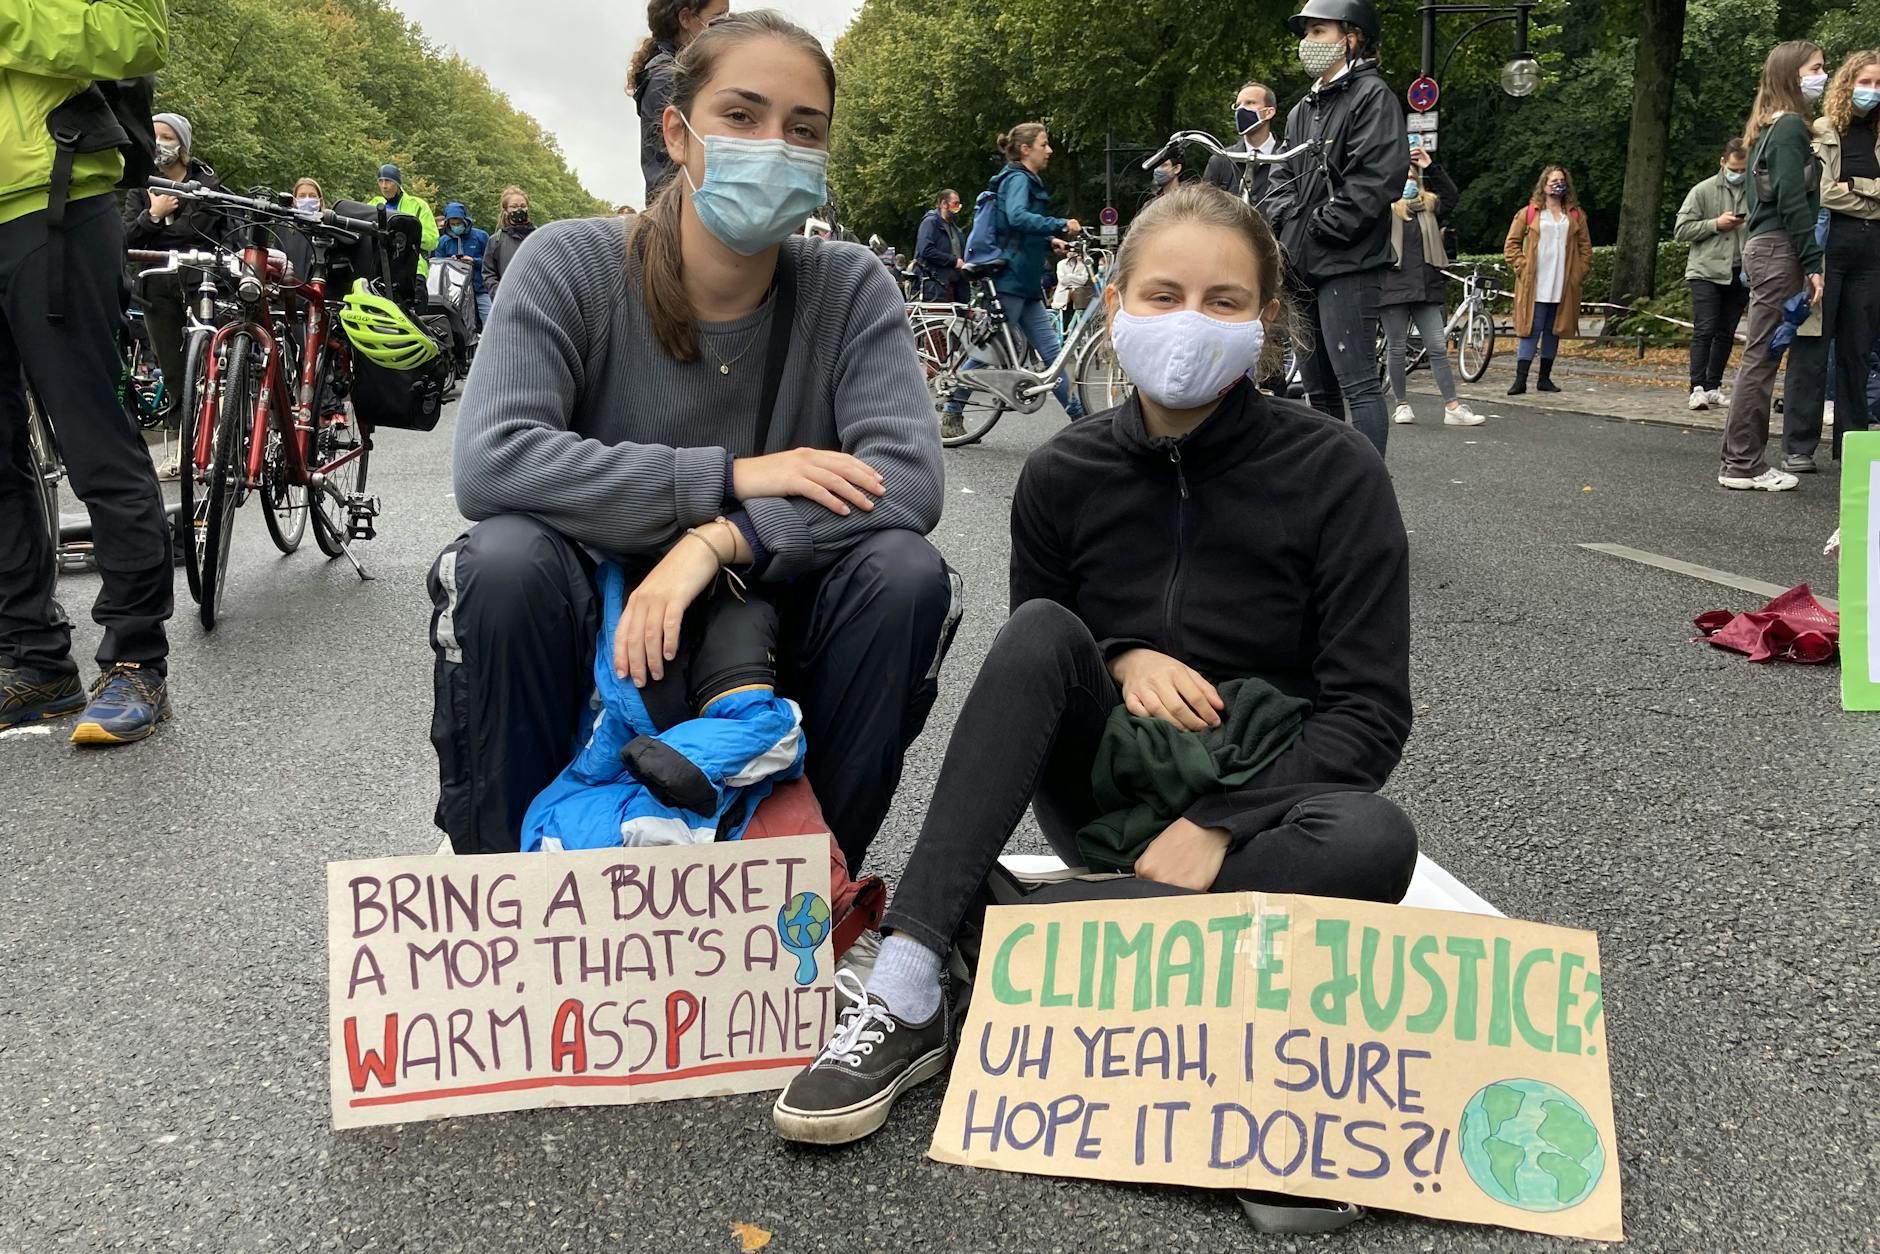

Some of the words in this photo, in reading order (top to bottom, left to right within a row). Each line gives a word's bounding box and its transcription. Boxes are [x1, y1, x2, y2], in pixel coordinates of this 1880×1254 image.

[348, 872, 522, 939] BRING
[543, 870, 586, 928] A
[601, 857, 807, 920] BUCKET
[347, 943, 388, 1000] A
[407, 936, 525, 993] MOP,
[534, 926, 727, 986] THAT'S
[744, 924, 778, 971] A
[990, 912, 1291, 1013] CLIMATE
[1310, 919, 1602, 1056] JUSTICE?
[343, 1005, 533, 1092] WARM
[551, 998, 658, 1074] ASS
[665, 986, 834, 1070] PLANET
[979, 1021, 1053, 1080] UH
[1073, 1023, 1217, 1089] YEAH,
[1245, 1022, 1253, 1083] I
[1274, 1028, 1432, 1114] SURE
[963, 1089, 1110, 1160] HOPE
[1135, 1101, 1191, 1165] IT
[1209, 1102, 1450, 1194] DOES?!
